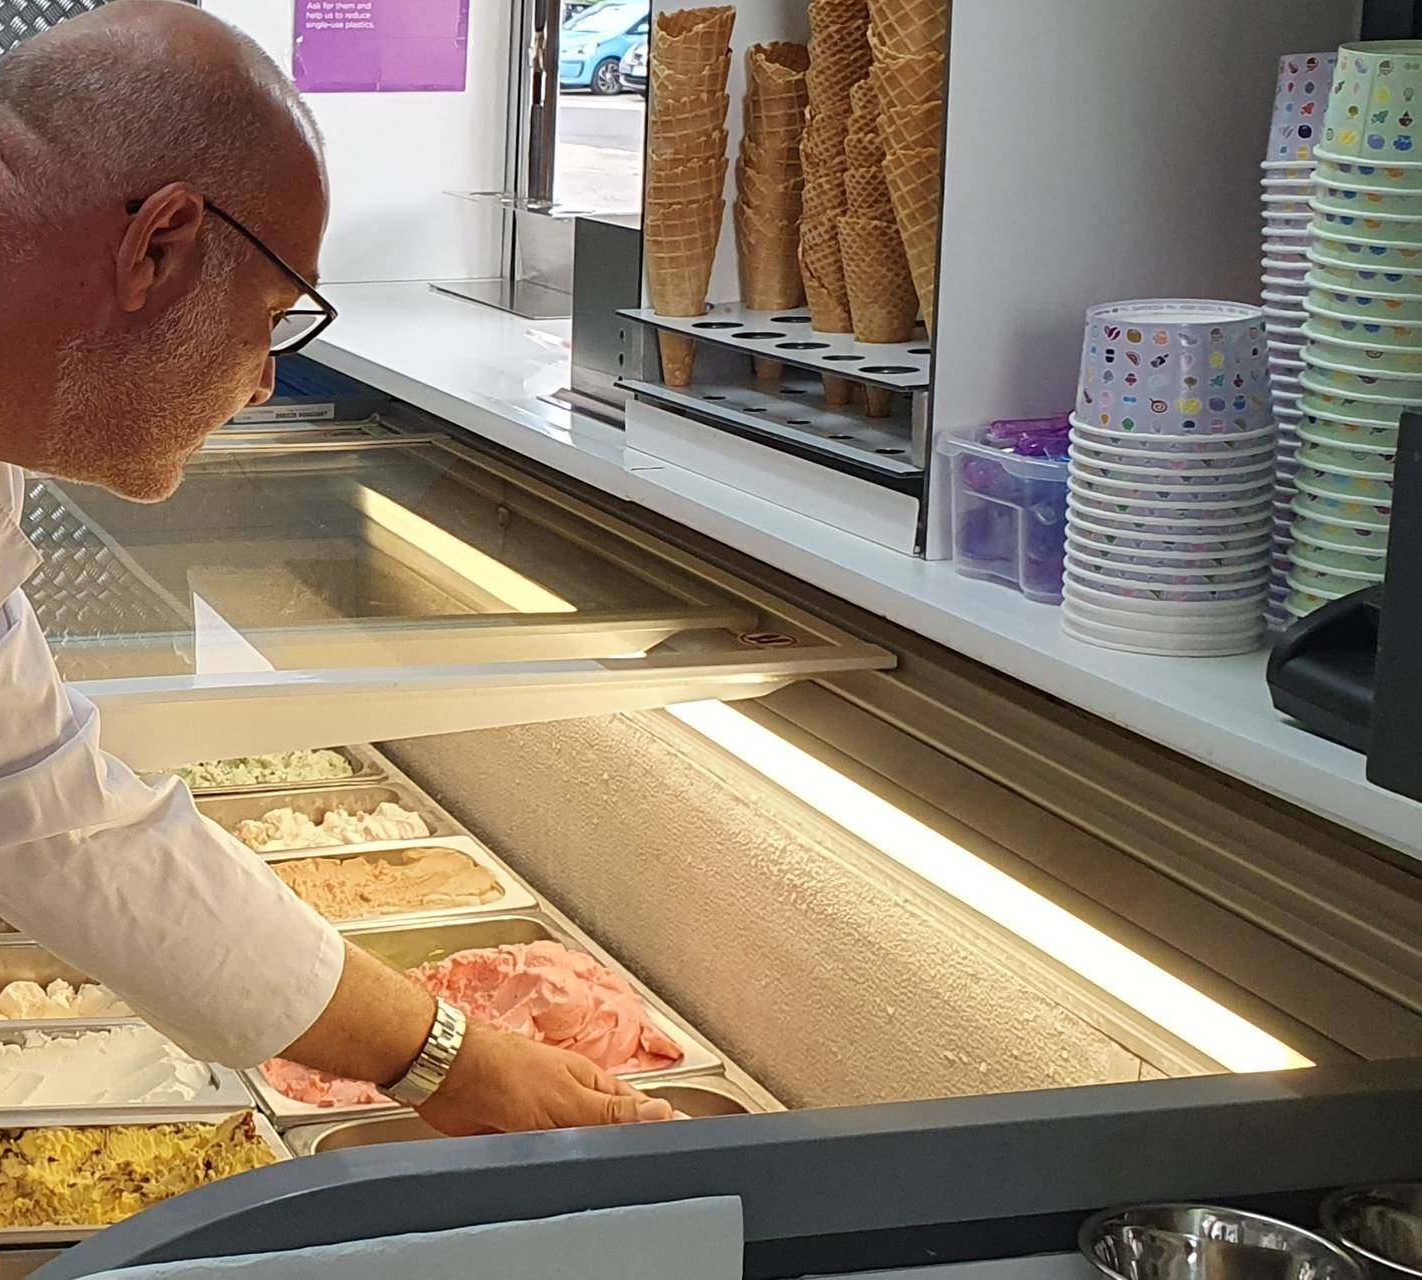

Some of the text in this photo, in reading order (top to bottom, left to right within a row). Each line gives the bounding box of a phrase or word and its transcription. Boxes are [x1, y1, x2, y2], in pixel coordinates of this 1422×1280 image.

[323, 1, 334, 10] for
[357, 2, 372, 10] and
[306, 12, 323, 20] help
